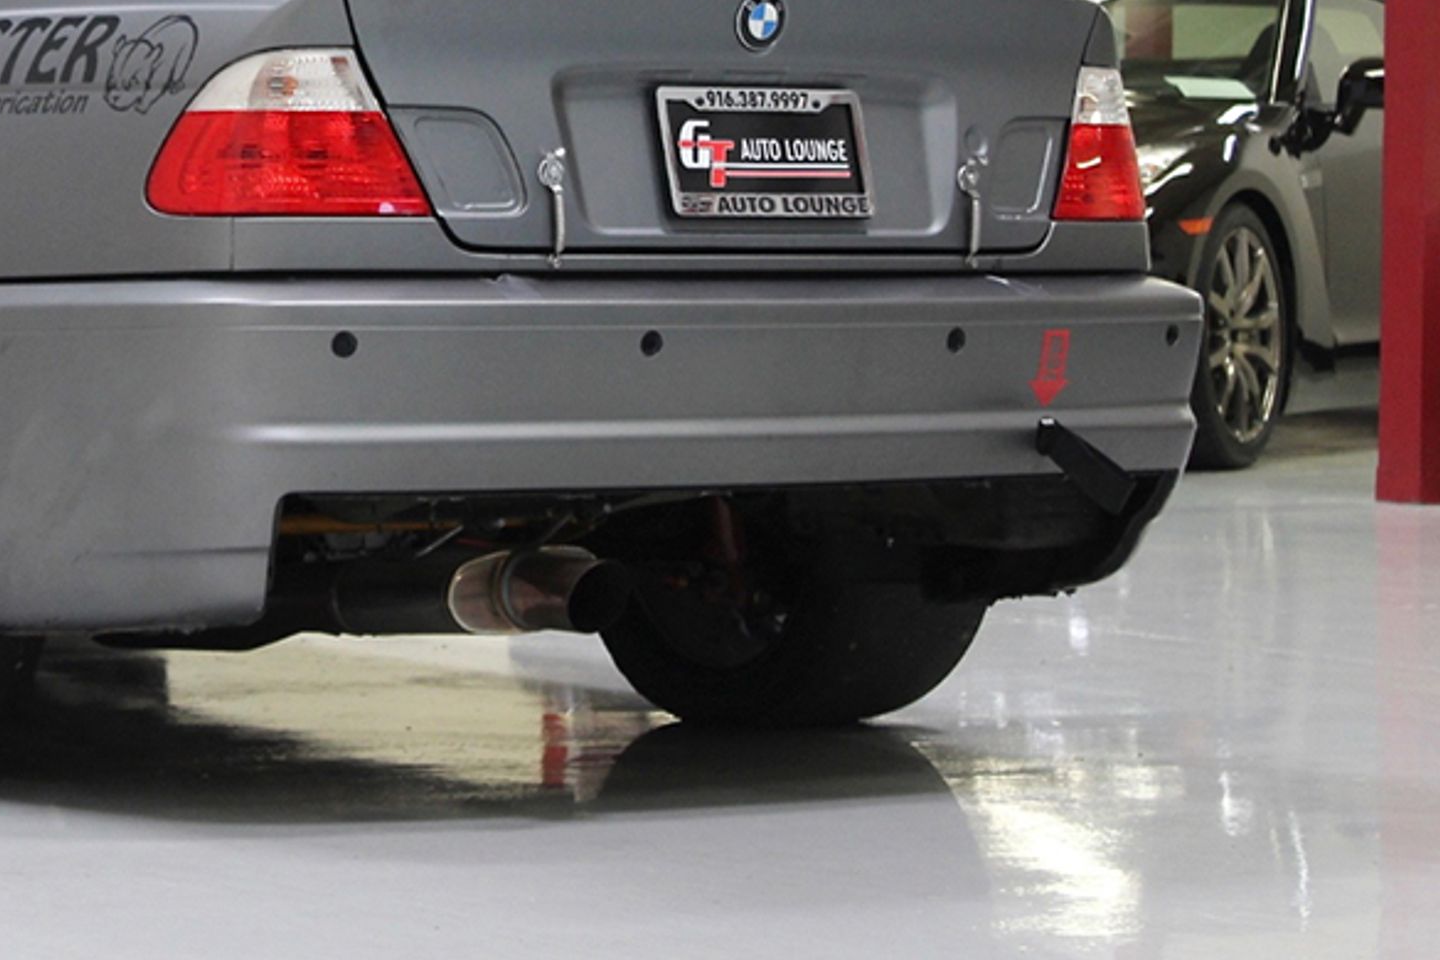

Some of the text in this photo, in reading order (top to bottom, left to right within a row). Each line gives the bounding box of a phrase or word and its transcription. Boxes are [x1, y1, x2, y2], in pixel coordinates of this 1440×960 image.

[741, 138, 782, 161] AUTO
[785, 139, 848, 162] LOUNGE
[717, 196, 776, 213] AUTO
[782, 196, 870, 214] LOUNGE
